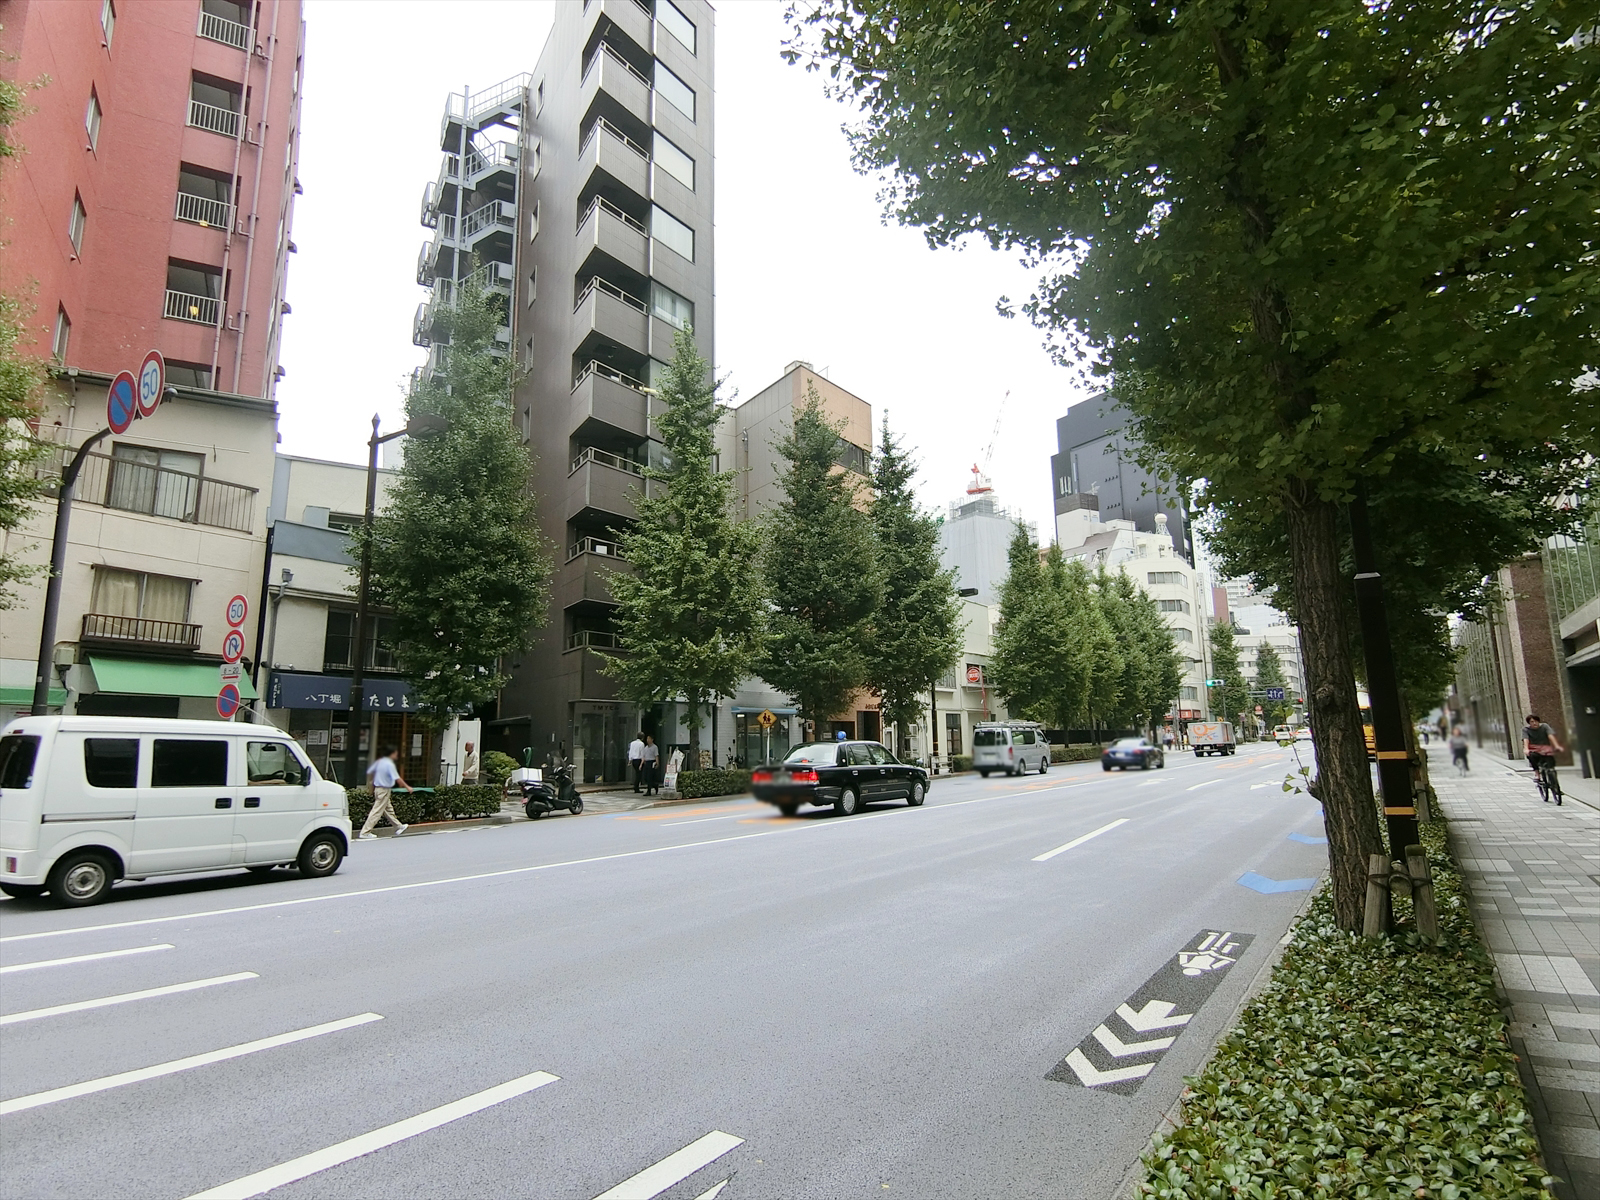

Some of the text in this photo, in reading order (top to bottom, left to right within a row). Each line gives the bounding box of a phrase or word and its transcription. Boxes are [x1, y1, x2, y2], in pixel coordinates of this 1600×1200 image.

[142, 368, 158, 400] 50
[231, 604, 243, 619] 50
[305, 694, 342, 704] 八丁堀
